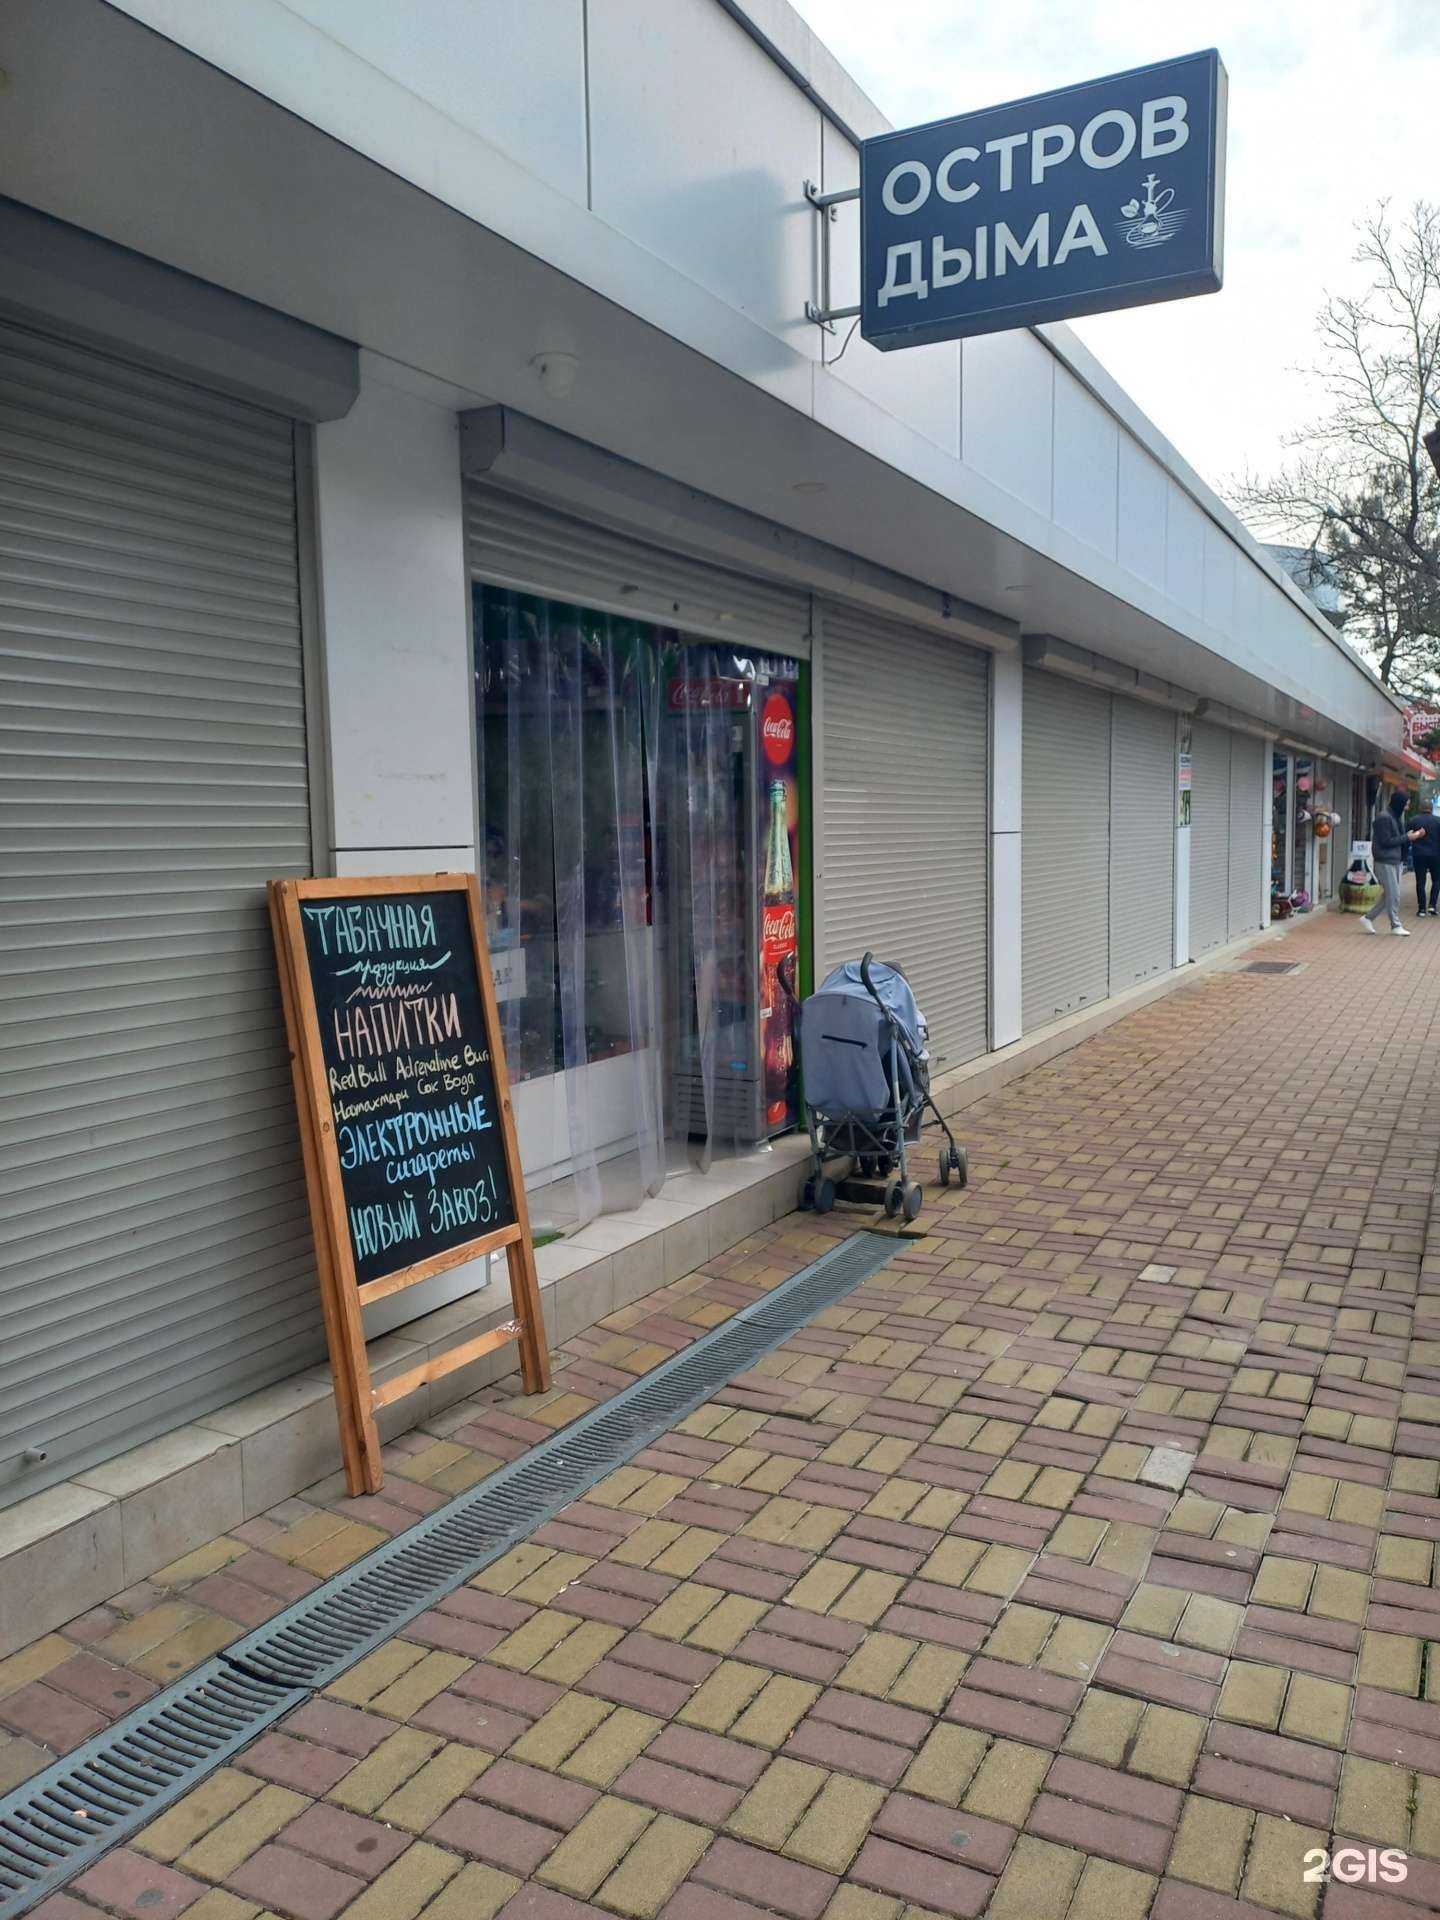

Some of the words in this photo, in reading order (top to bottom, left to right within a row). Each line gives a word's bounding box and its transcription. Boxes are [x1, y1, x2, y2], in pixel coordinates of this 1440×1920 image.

[882, 95, 1189, 216] ОСТРОВ
[877, 204, 1109, 307] ДЫМА
[303, 904, 437, 955] ТАБАЧНАЯ
[343, 955, 442, 987] продукция
[334, 993, 462, 1061] НАПИТКИ
[396, 1048, 462, 1081] Adrenaline
[339, 1095, 492, 1169] ЭЛЕКТРОННЫЕ
[351, 1190, 421, 1261] НОВЫЙ
[427, 1165, 498, 1234] ЗАВОЗ!
